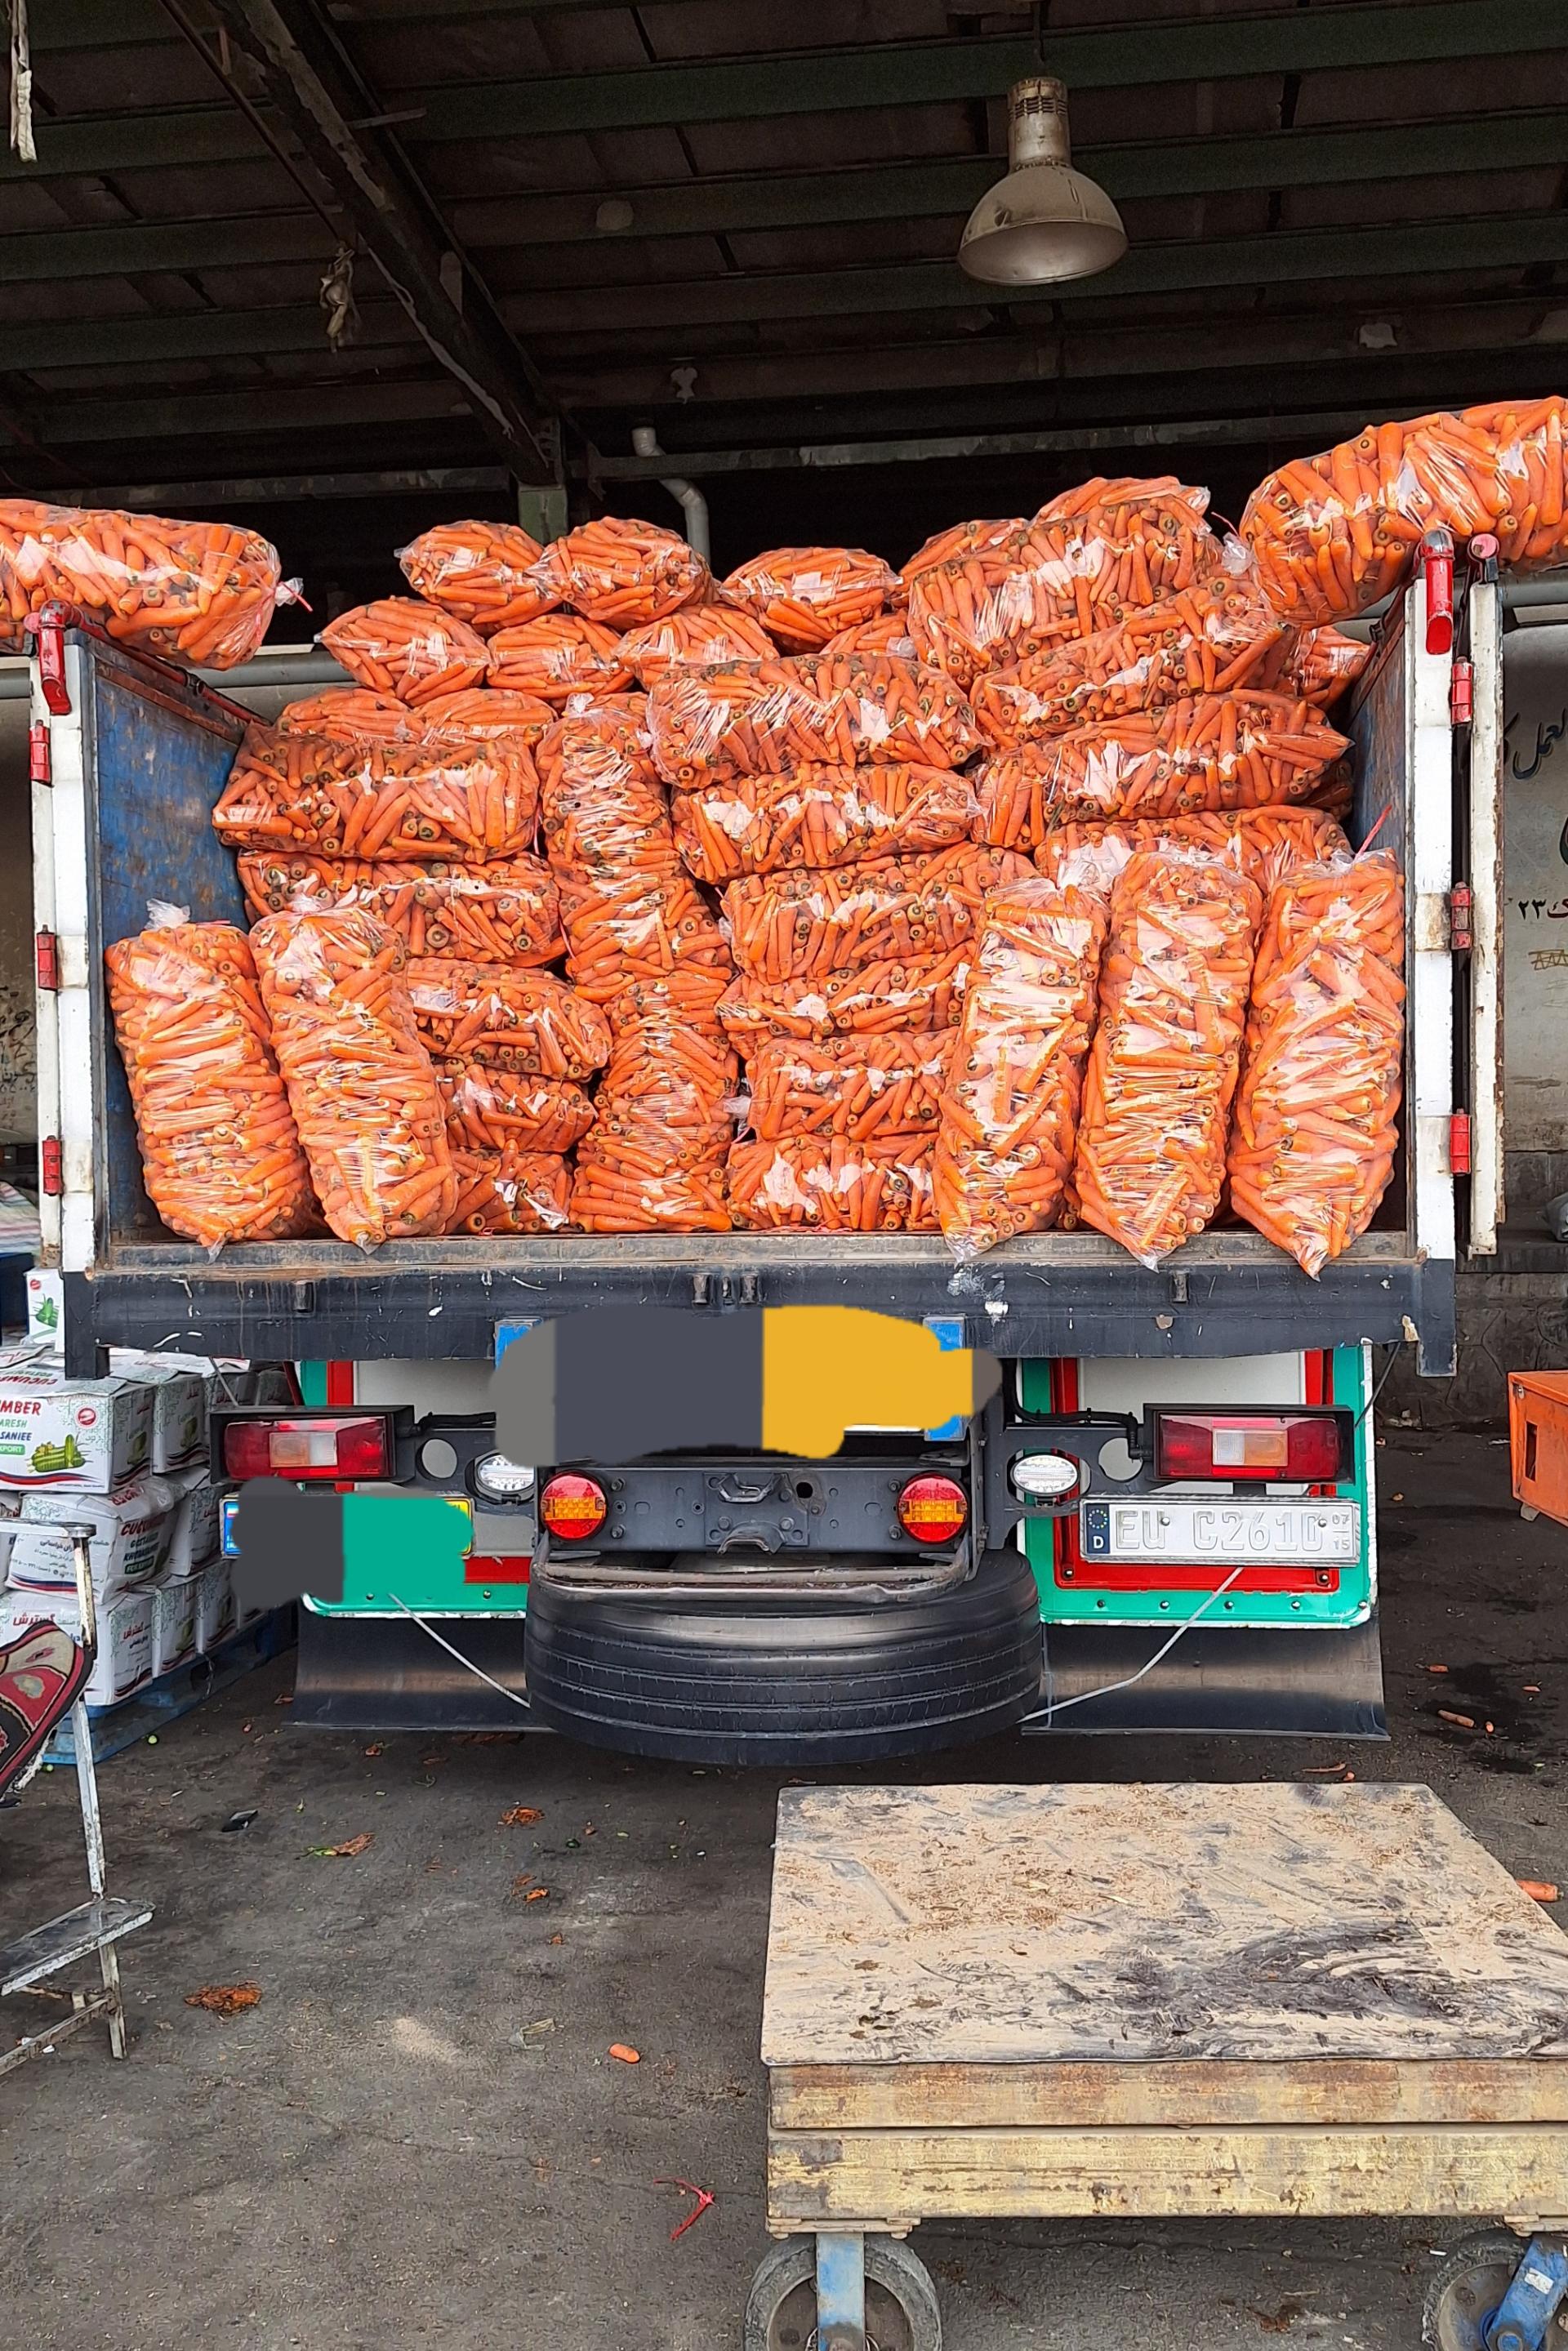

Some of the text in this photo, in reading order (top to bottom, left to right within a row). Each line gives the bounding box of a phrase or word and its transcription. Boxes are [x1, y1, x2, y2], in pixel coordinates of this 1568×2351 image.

[0, 1400, 42, 1416] MBER
[1332, 1513, 1350, 1525] 07
[1093, 1535, 1104, 1549] D
[1115, 1507, 1165, 1550] EU
[1333, 1538, 1350, 1550] 15
